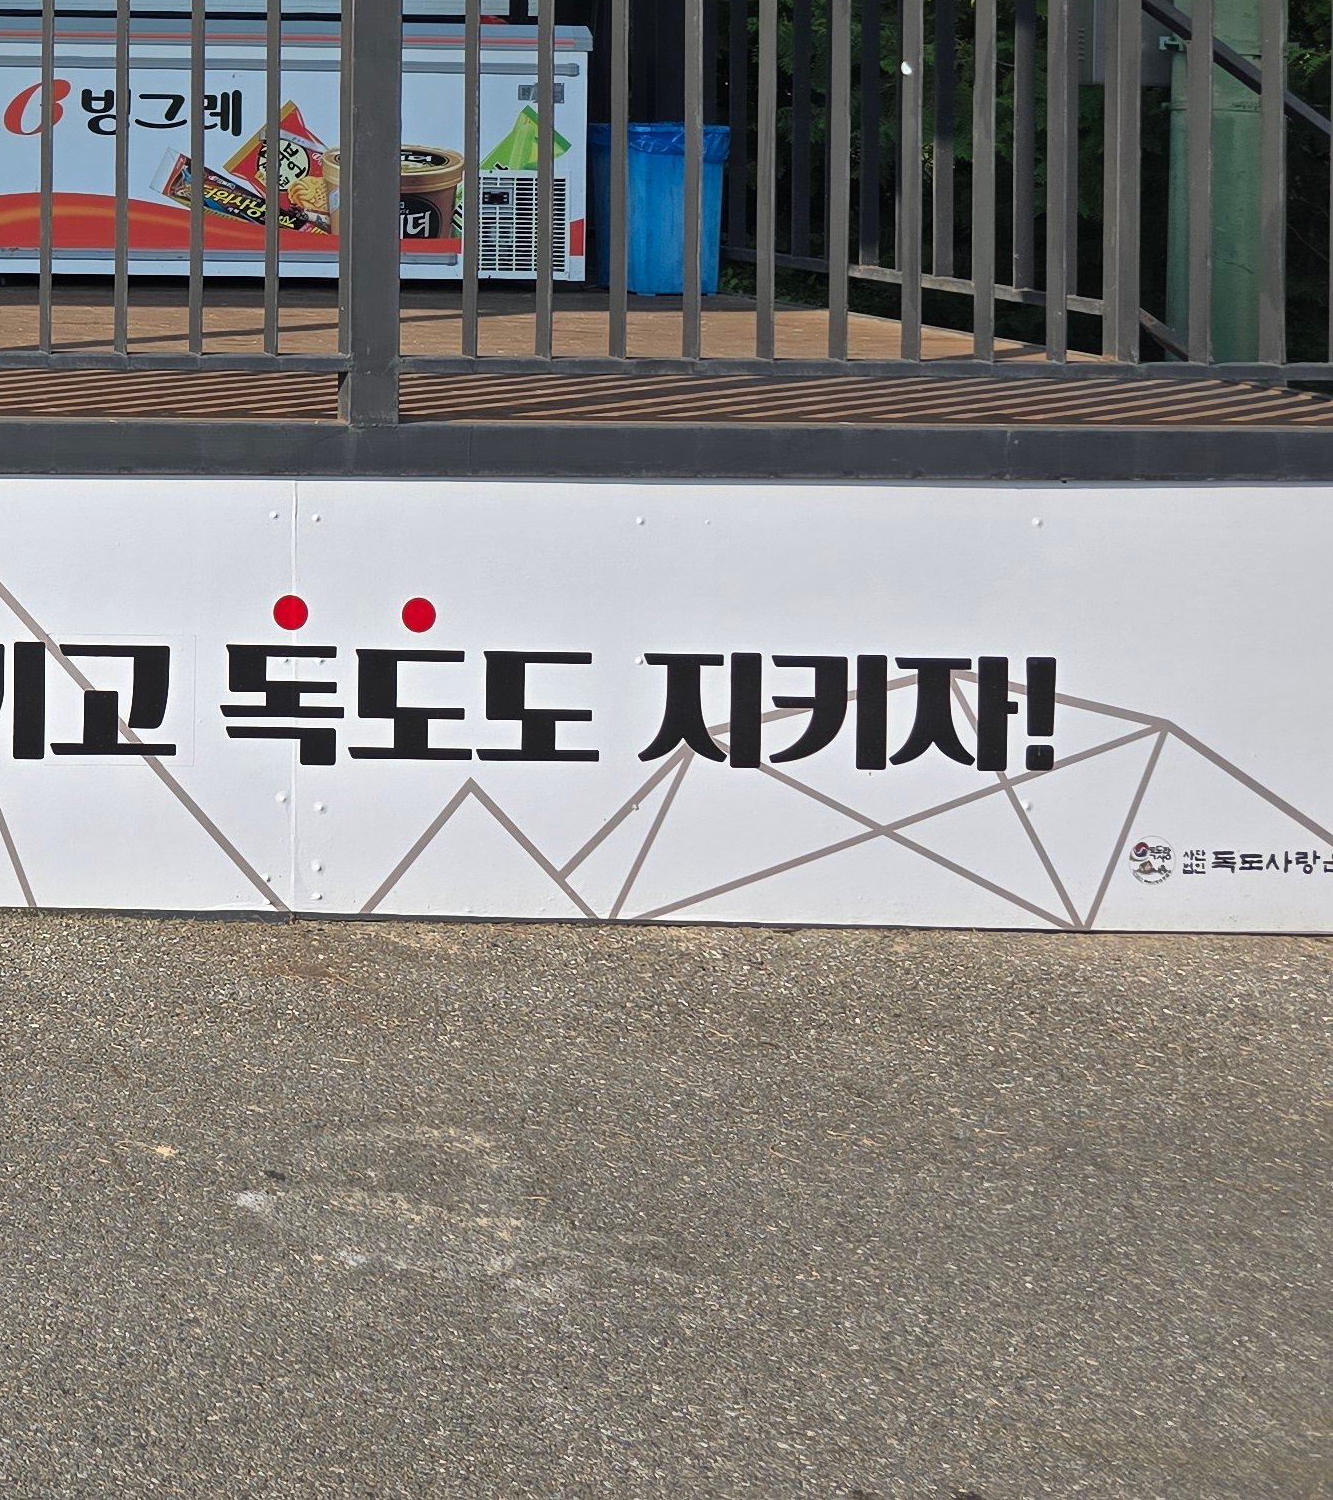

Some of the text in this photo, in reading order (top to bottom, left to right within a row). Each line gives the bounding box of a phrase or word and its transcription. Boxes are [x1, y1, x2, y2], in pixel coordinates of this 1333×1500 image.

[80, 88, 243, 137] 빙그레
[220, 643, 600, 766] 독도도
[637, 652, 1057, 772] 지키자!
[1183, 849, 1207, 862] 사단
[1183, 862, 1207, 875] 법인
